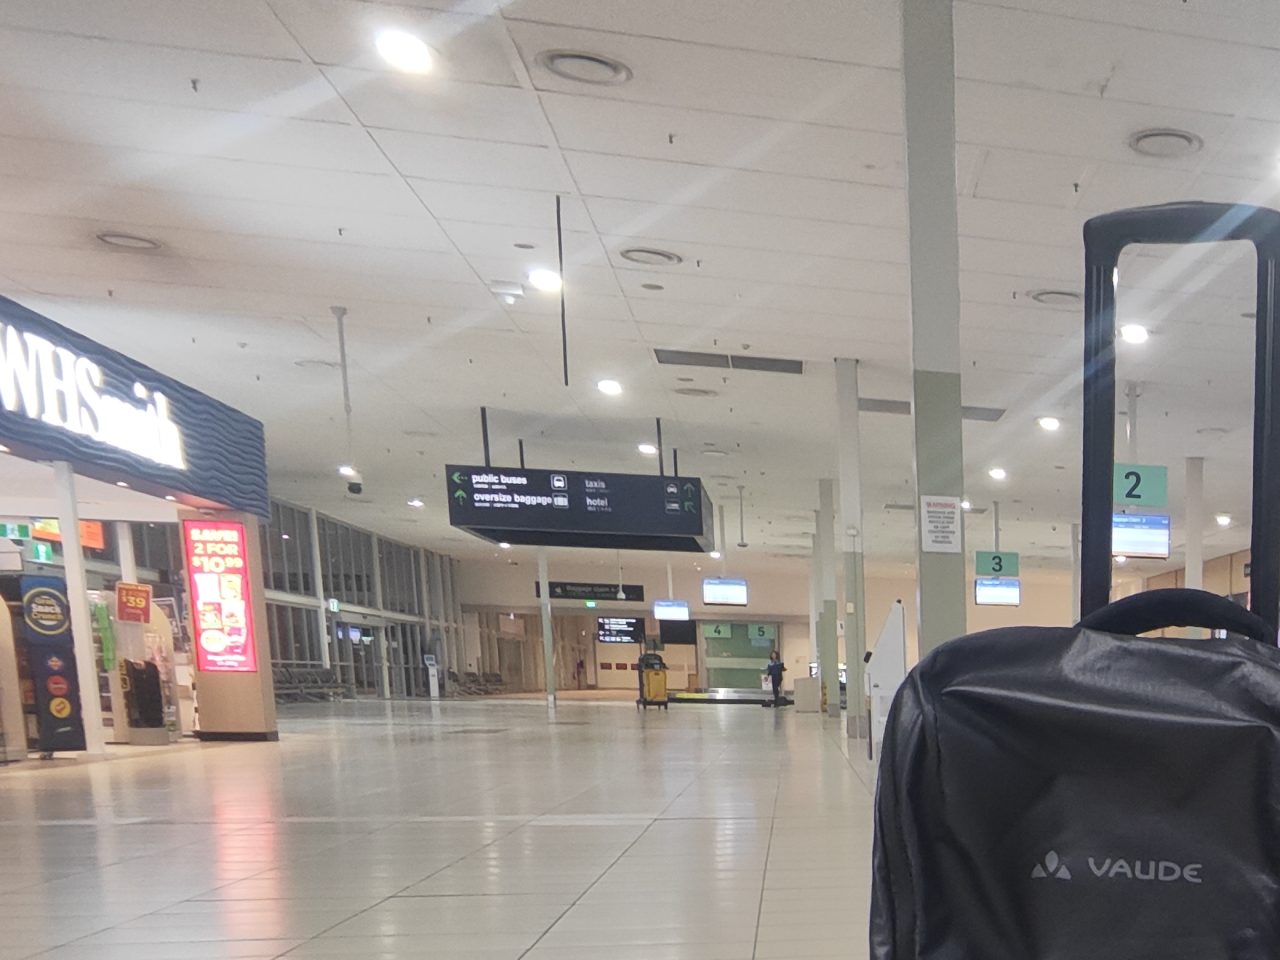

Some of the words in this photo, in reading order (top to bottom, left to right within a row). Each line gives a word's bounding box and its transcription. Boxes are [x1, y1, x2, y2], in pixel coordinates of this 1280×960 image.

[471, 474, 499, 484] public
[500, 474, 528, 485] buses
[585, 480, 606, 489] taxis
[1124, 470, 1142, 500] 2
[473, 492, 512, 502] oversize
[513, 493, 552, 506] baggage
[585, 497, 608, 507] hotel
[206, 543, 239, 555] FOR
[991, 555, 1003, 573] 3
[713, 625, 722, 636] 4
[757, 626, 766, 637] 5
[1087, 856, 1203, 883] VAUDE
